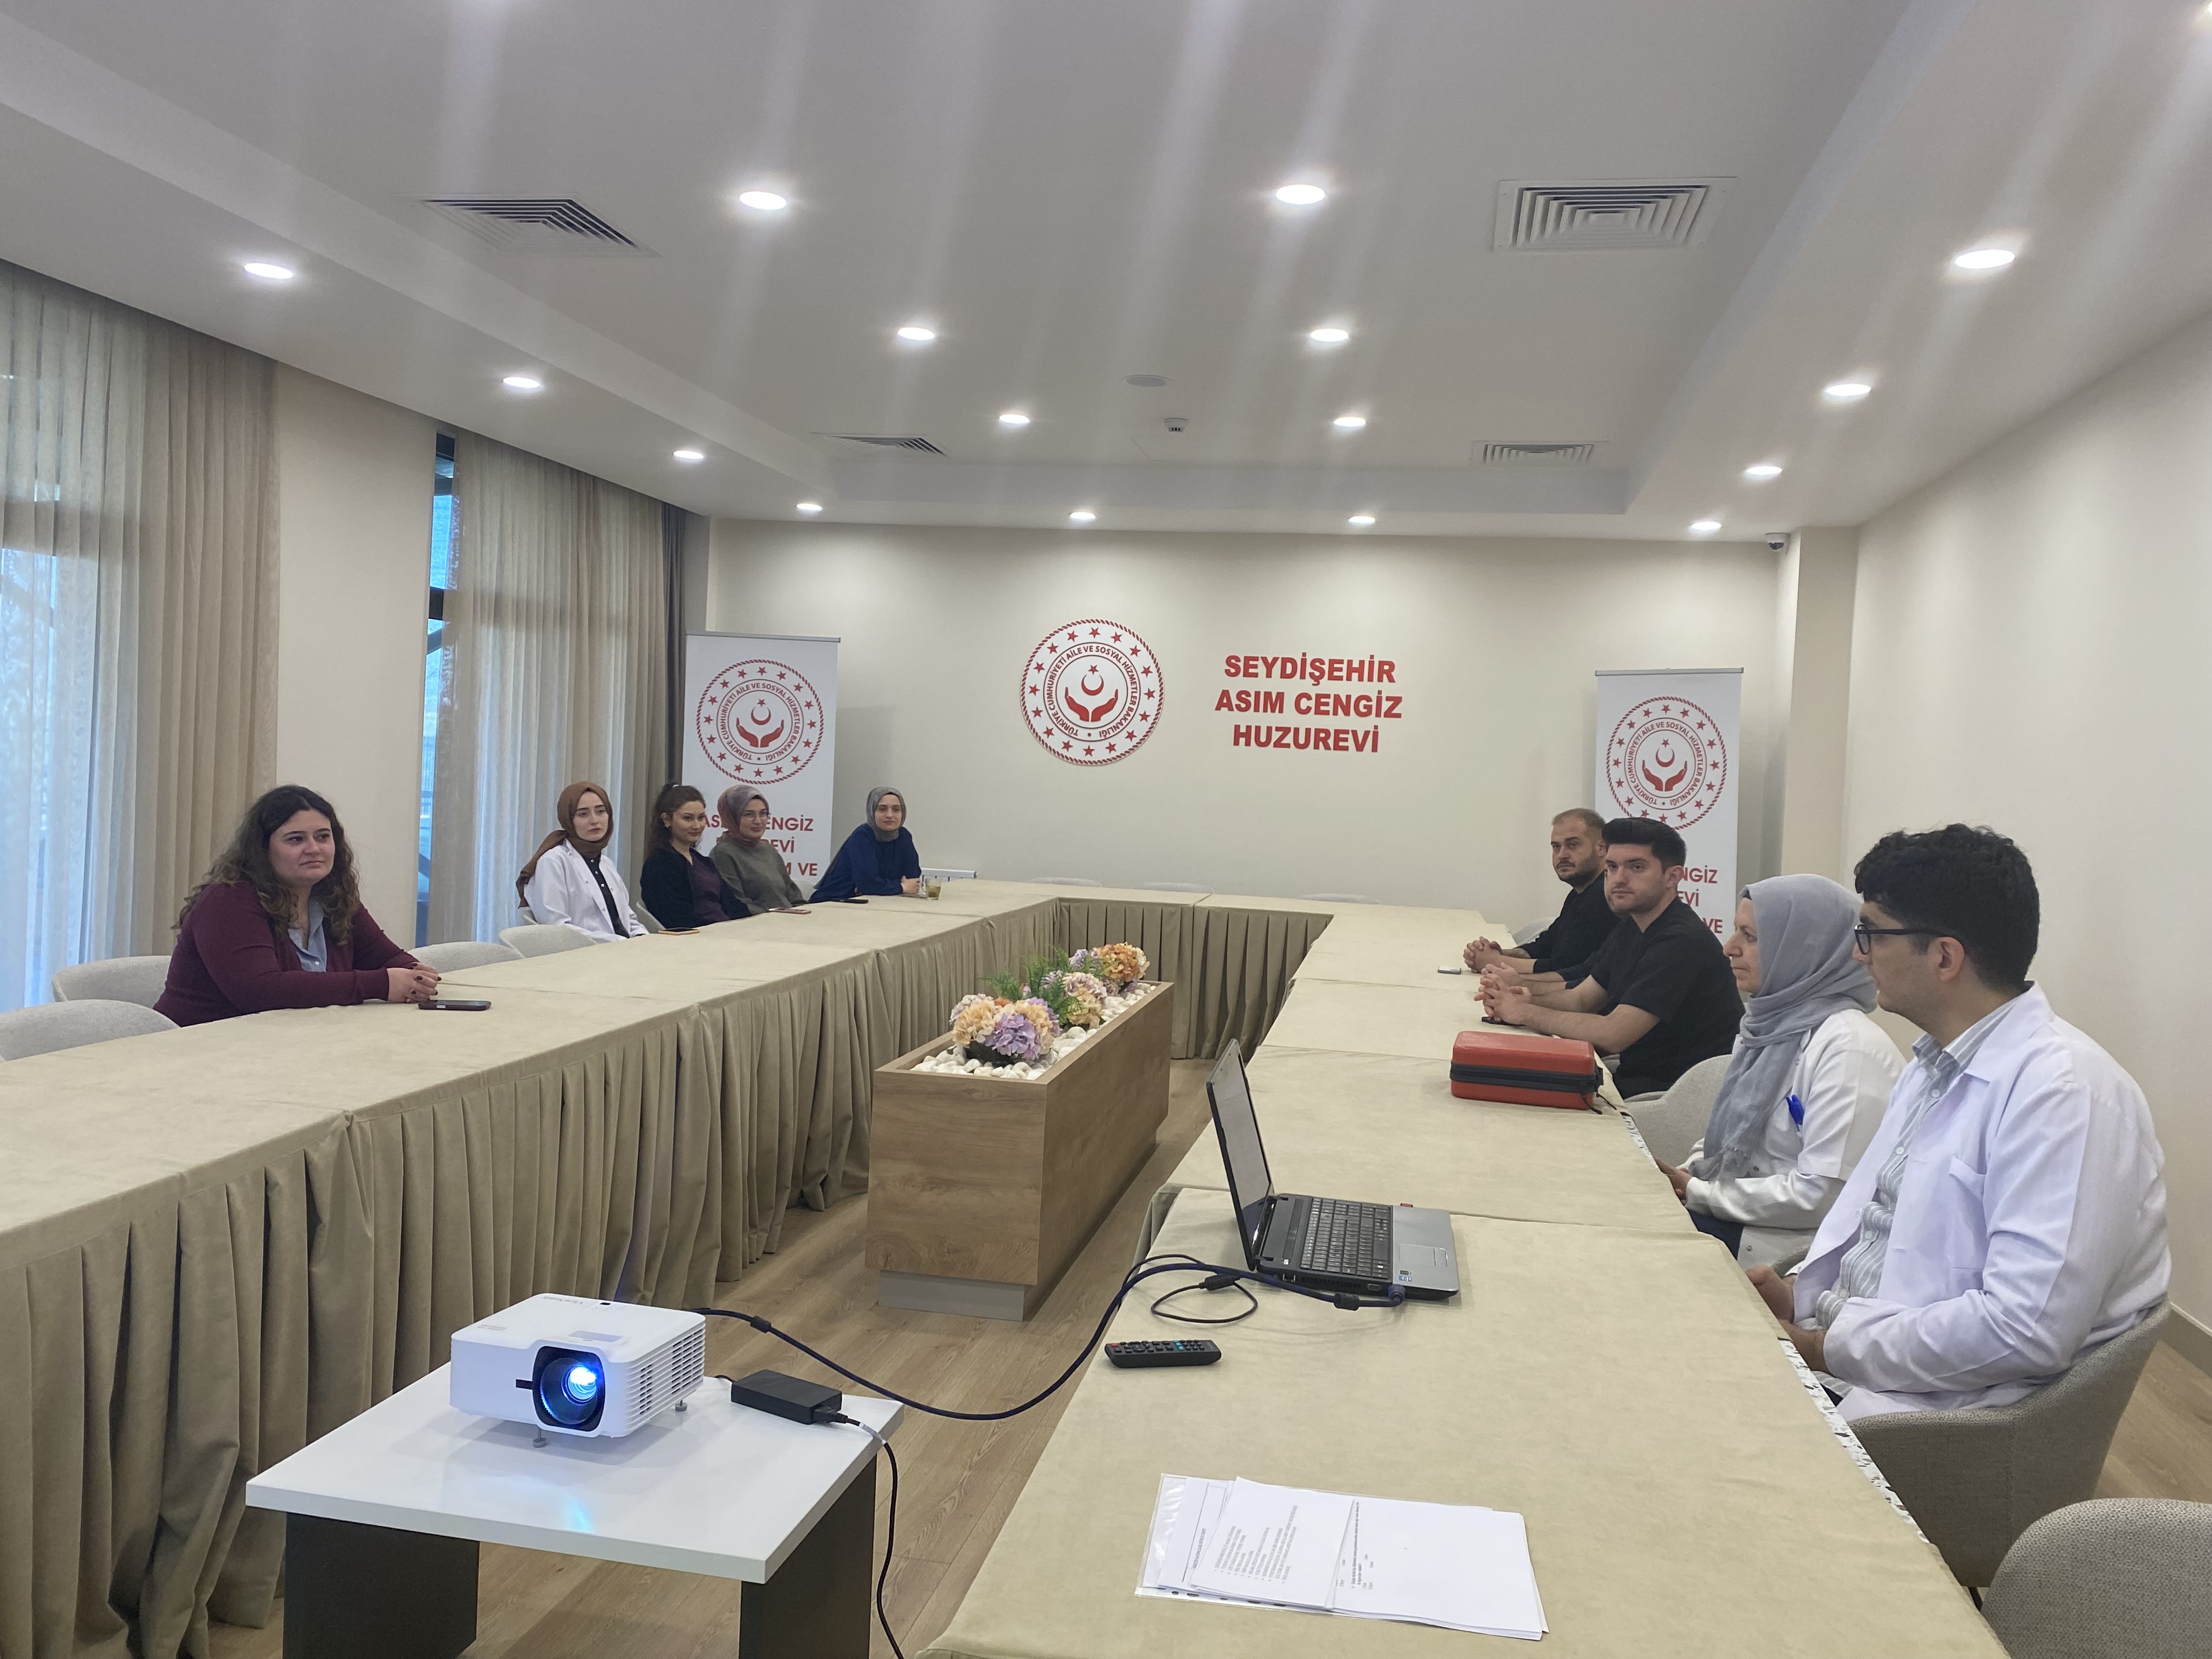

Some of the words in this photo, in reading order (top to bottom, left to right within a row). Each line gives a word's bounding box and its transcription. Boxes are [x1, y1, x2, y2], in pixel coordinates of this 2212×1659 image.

[1066, 647, 1082, 660] AİLE
[1095, 646, 1121, 663] SOSYAL
[1224, 652, 1396, 686] SEYDİŞEHİR
[736, 684, 751, 695] AİLE
[762, 682, 786, 698] SOSYAL
[1047, 656, 1066, 710] CUMHURİYETİ
[1121, 661, 1138, 706] HİZMETLER
[720, 692, 737, 740] CUMHURİYETİ
[786, 696, 800, 734] HİZMETLER
[1215, 689, 1285, 714] ASIM
[1294, 690, 1403, 719] CENGİZ
[1052, 710, 1078, 736] TÜRKİYE
[1099, 707, 1134, 738] BAKANLIĞI
[1641, 724, 1656, 737] AİLE
[1666, 721, 1689, 737] SOSYAL
[727, 740, 752, 760] TÜRKİYE
[765, 735, 797, 761] BAKANLIĞI
[1233, 724, 1379, 753] HUZUREVİ
[1627, 733, 1643, 783] CUMHURİYETİ
[1689, 735, 1703, 776] HİZMETLER
[1634, 783, 1657, 805] TÜRKİYE
[1669, 777, 1700, 806] BAKANLIĞI
[797, 862, 817, 876] VE
[1702, 917, 1723, 934] VE
